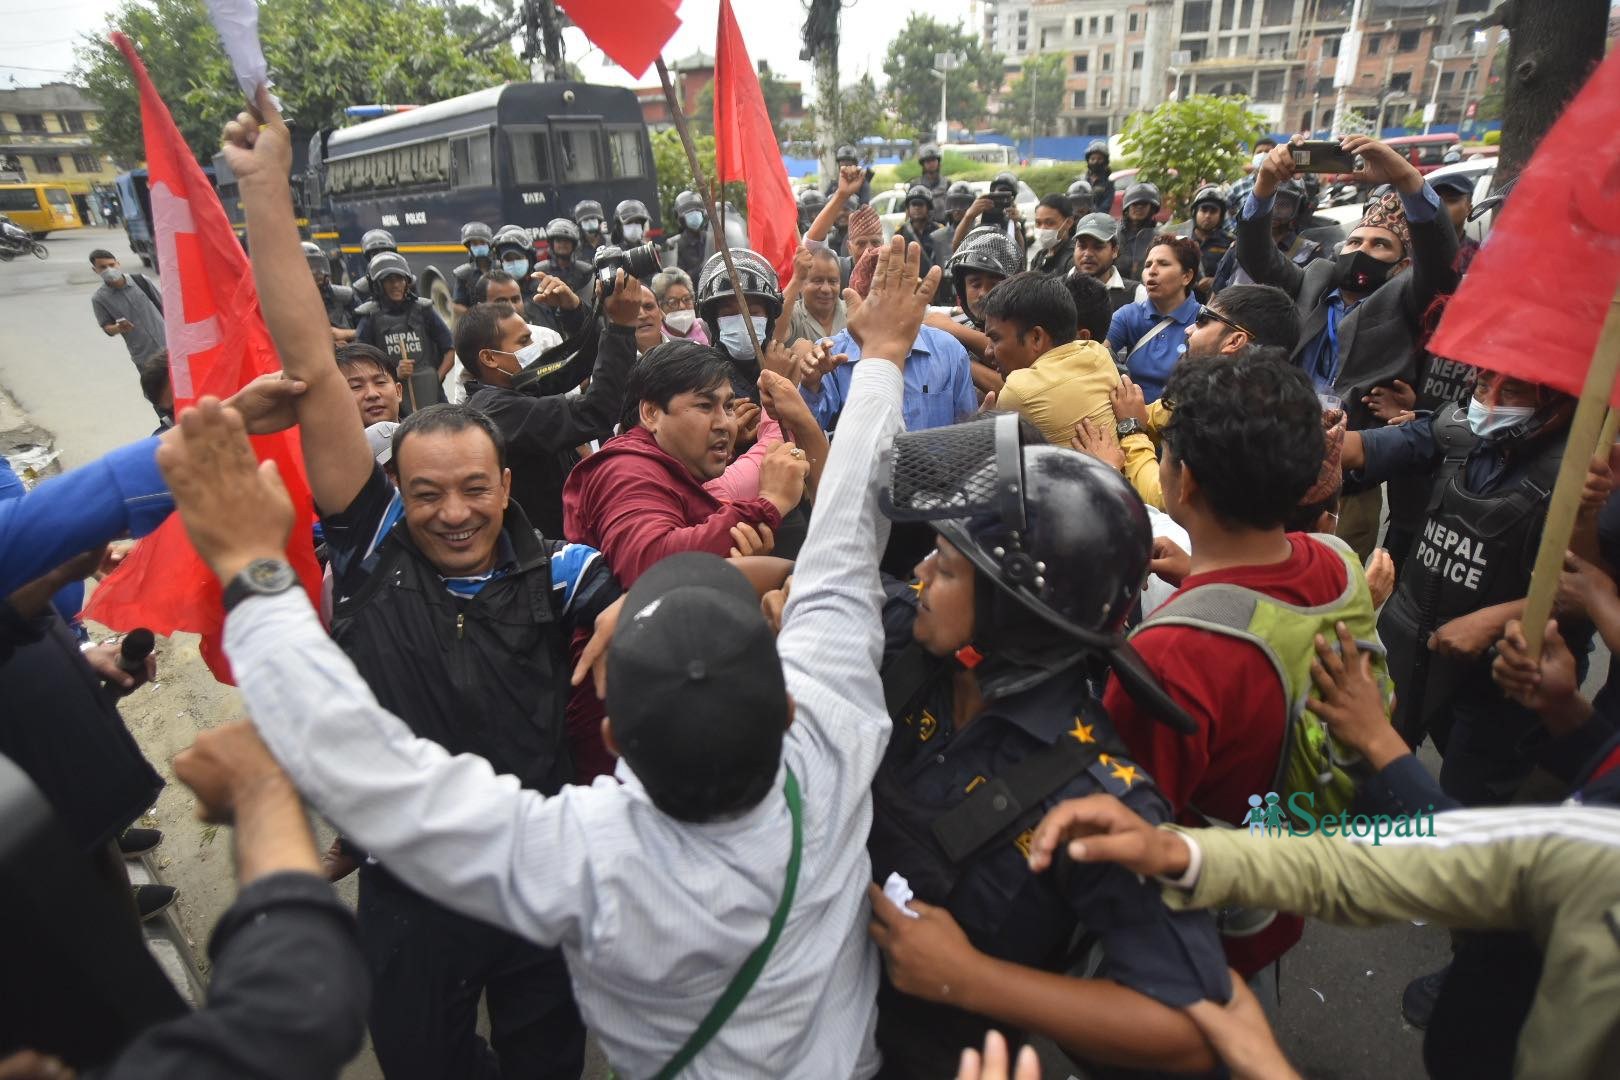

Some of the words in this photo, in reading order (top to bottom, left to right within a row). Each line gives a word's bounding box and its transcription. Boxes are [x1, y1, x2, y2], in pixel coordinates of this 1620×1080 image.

[522, 192, 546, 205] TATA
[385, 331, 420, 345] NEPAL
[387, 341, 422, 356] POICE
[1430, 356, 1478, 383] NEPA
[1423, 377, 1471, 402] POLIC
[1424, 517, 1487, 566] NEPAL
